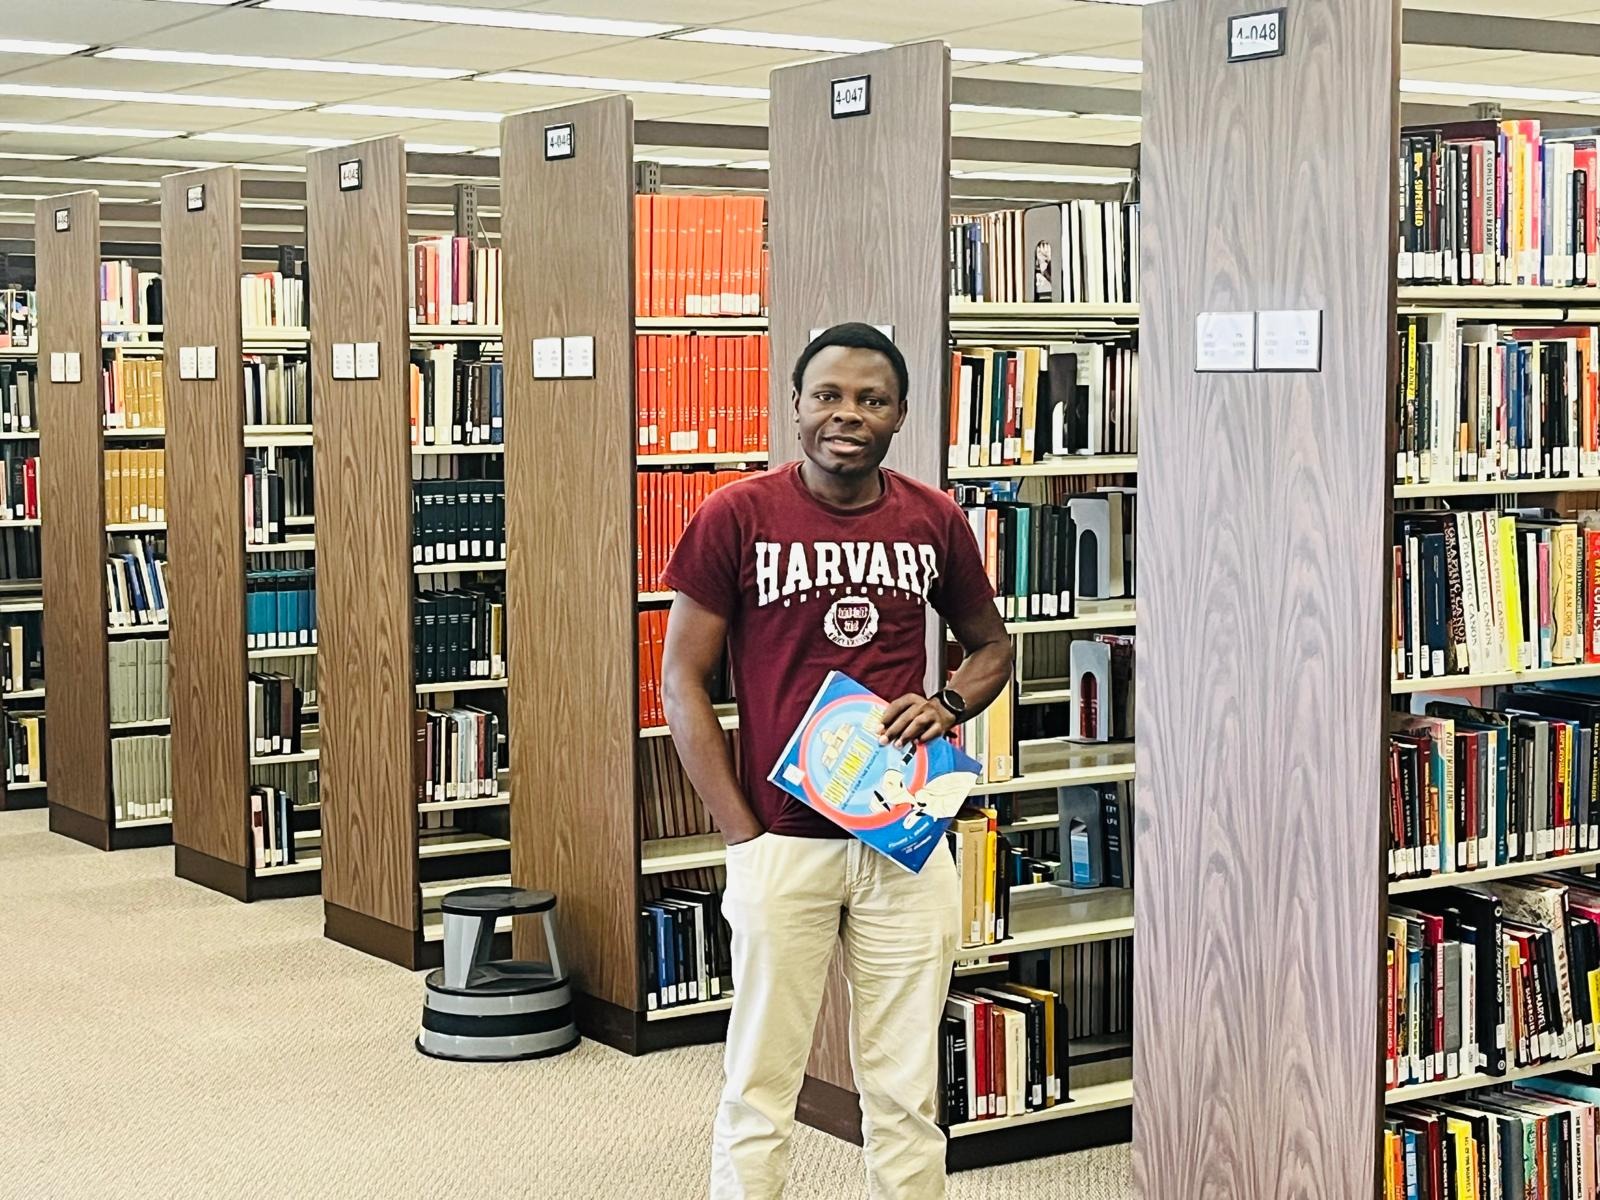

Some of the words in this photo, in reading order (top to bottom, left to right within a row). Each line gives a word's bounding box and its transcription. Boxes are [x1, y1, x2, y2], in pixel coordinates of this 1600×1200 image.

[835, 87, 864, 105] 4-047
[1414, 179, 1424, 227] SUPERHERO
[1489, 518, 1497, 535] 3
[755, 542, 939, 606] HARVARD
[1566, 574, 1573, 585] AT
[1564, 611, 1573, 637] DIEGO
[1446, 732, 1453, 746] NO
[821, 734, 874, 806] GOVERNMENT
[1525, 987, 1536, 1035] SUPERGIRL
[1535, 993, 1546, 1031] MARVEL
